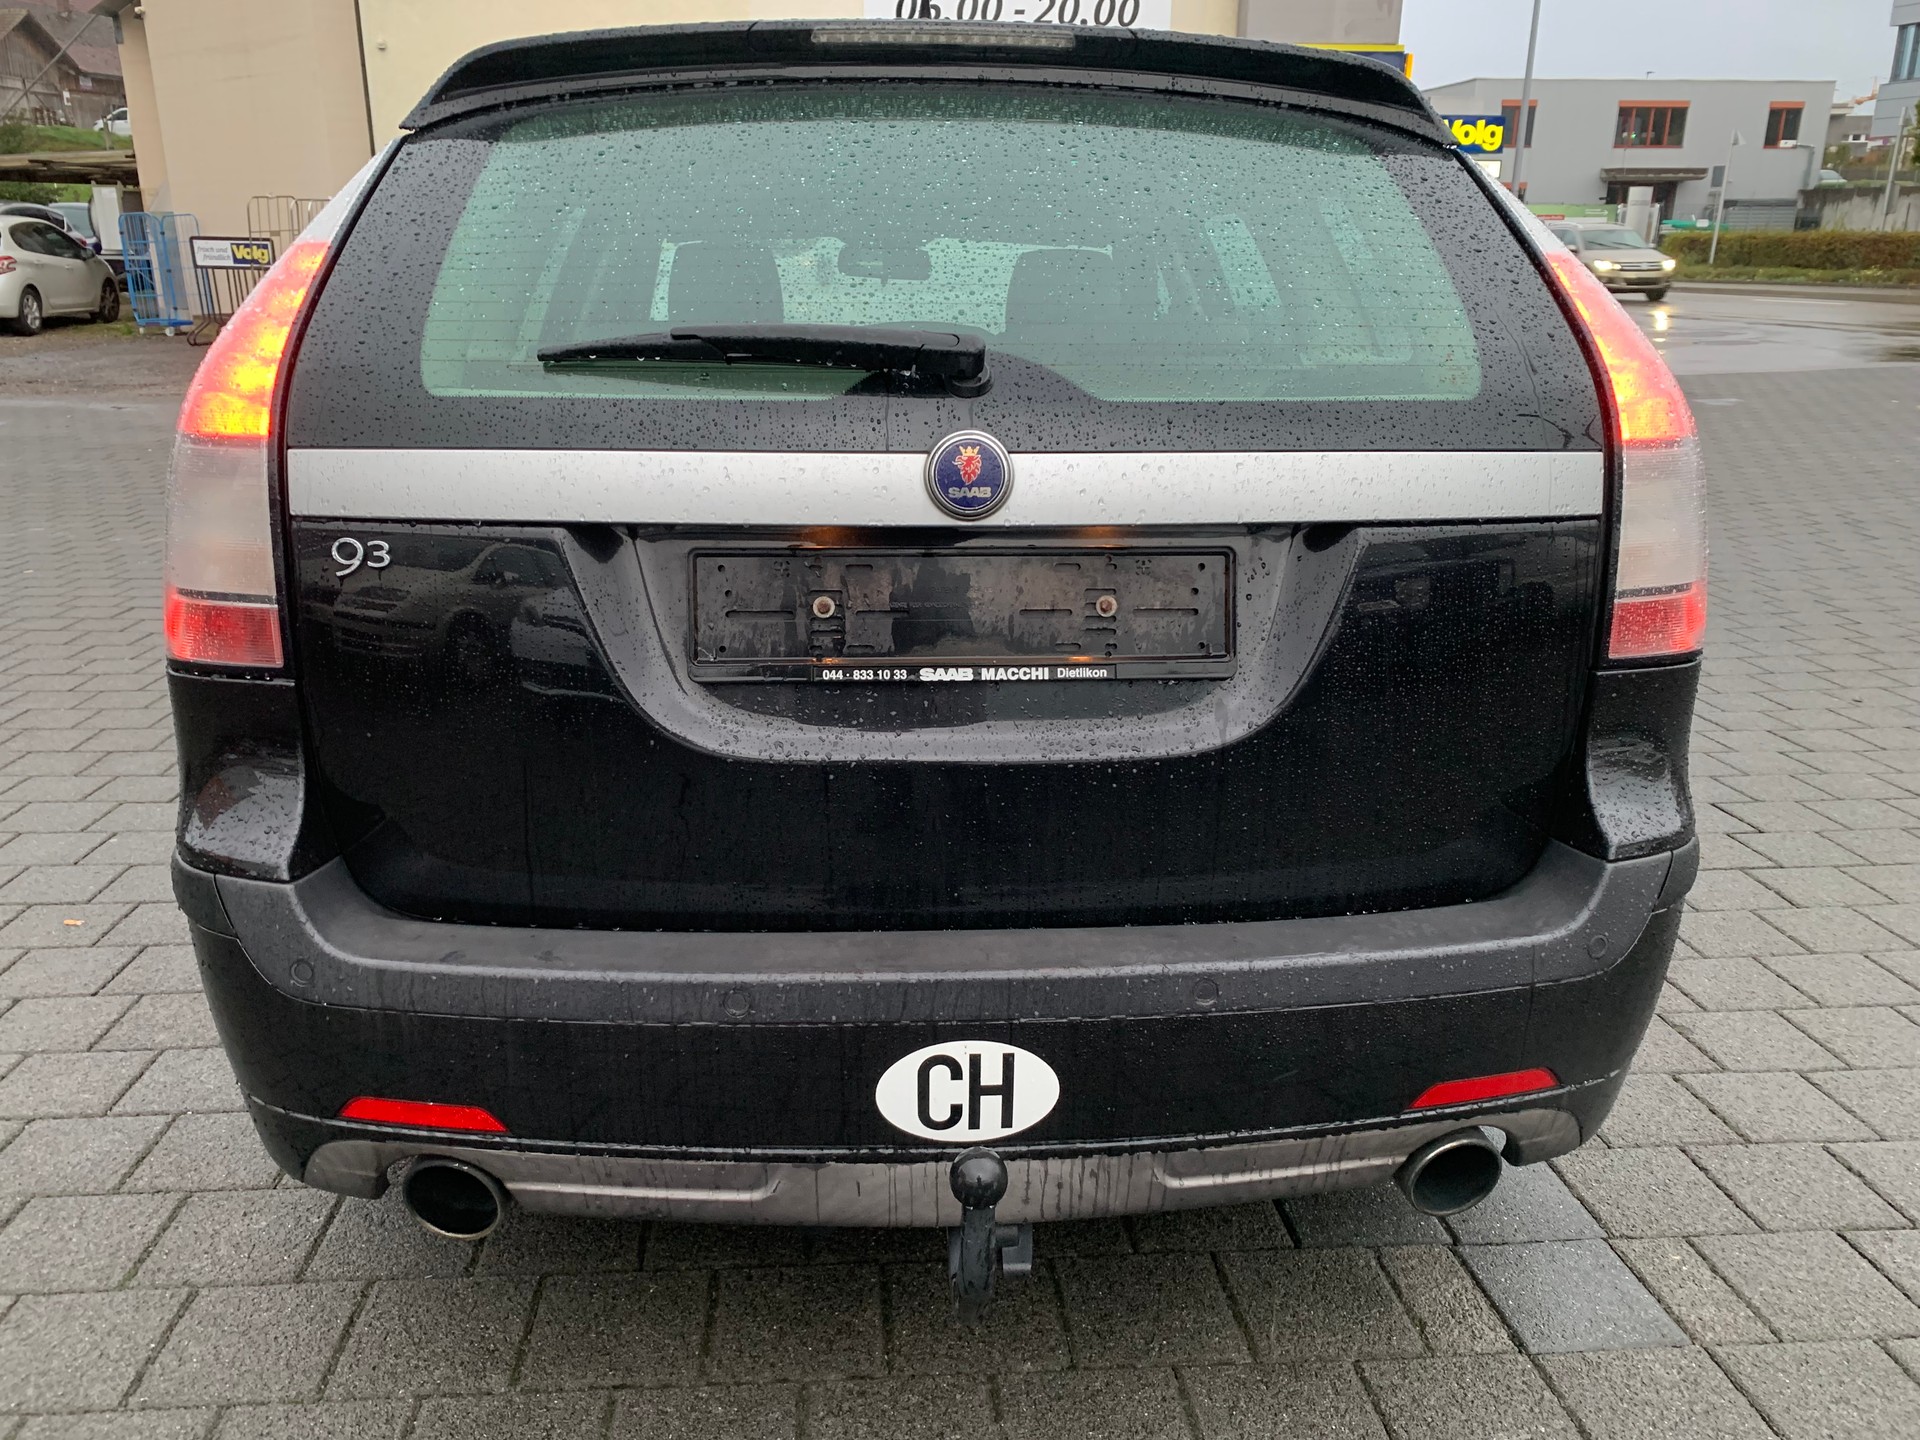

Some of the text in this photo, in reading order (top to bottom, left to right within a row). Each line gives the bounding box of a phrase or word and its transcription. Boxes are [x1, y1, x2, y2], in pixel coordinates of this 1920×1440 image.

[231, 245, 269, 264] Volg
[947, 486, 992, 498] SAAB
[331, 537, 391, 577] 93
[822, 669, 844, 680] 044
[853, 669, 874, 680] 833
[877, 669, 891, 680] 10
[893, 669, 908, 680] 33
[919, 667, 974, 682] SAAB
[981, 667, 1050, 681] MACCHI
[1057, 667, 1108, 679] Dietlikon
[917, 1052, 1015, 1131] CH
